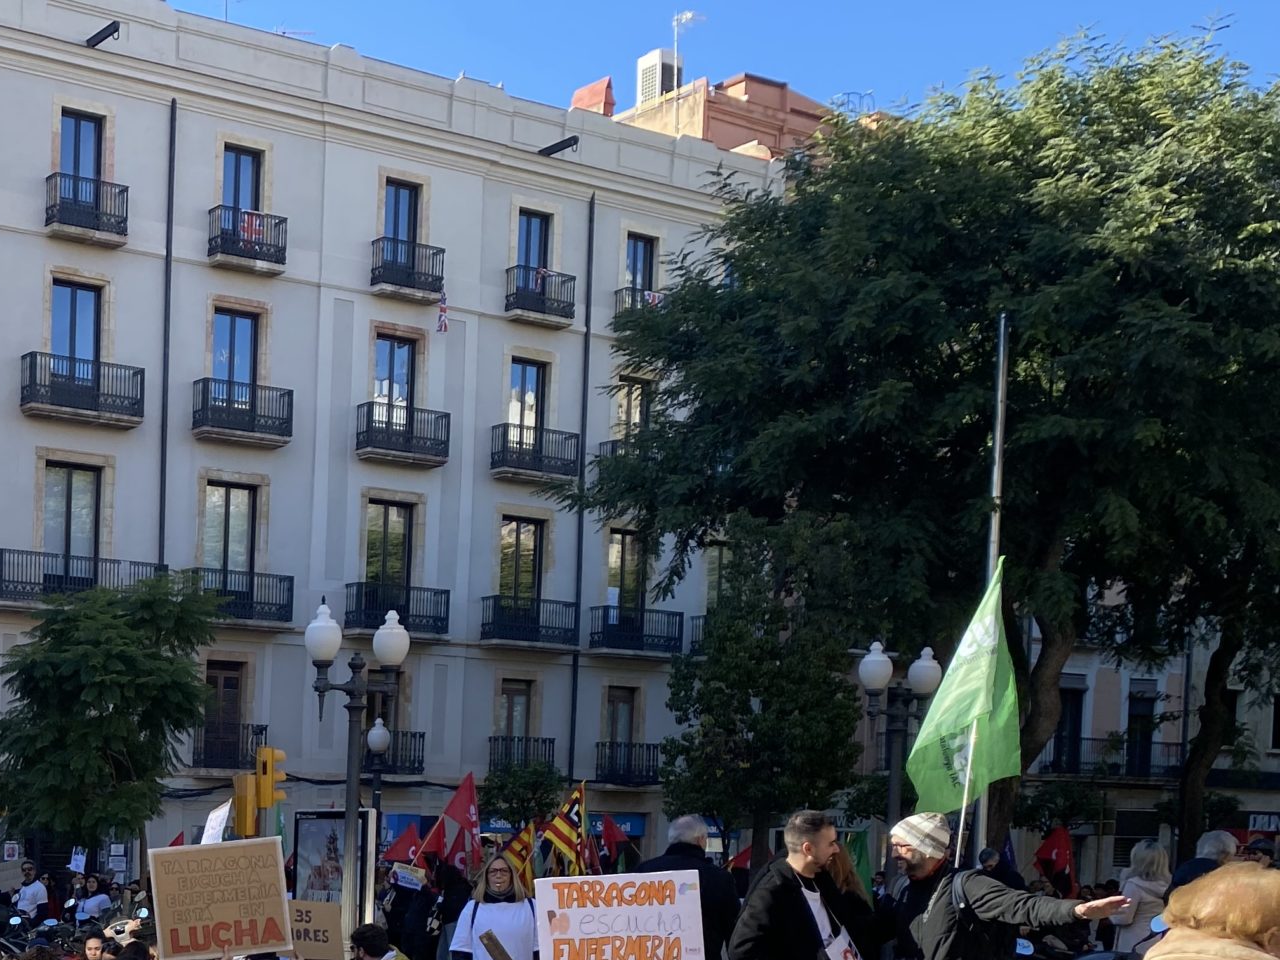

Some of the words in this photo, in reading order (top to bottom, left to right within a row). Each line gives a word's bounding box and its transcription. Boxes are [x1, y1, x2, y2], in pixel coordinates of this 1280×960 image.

[162, 855, 278, 875] TARRAGONA
[178, 869, 260, 891] ESCUCHA
[552, 879, 676, 910] TARRAGONA
[239, 902, 265, 918] EN
[294, 909, 312, 924] 35
[579, 912, 685, 936] escucha
[170, 917, 286, 954] LUCHA
